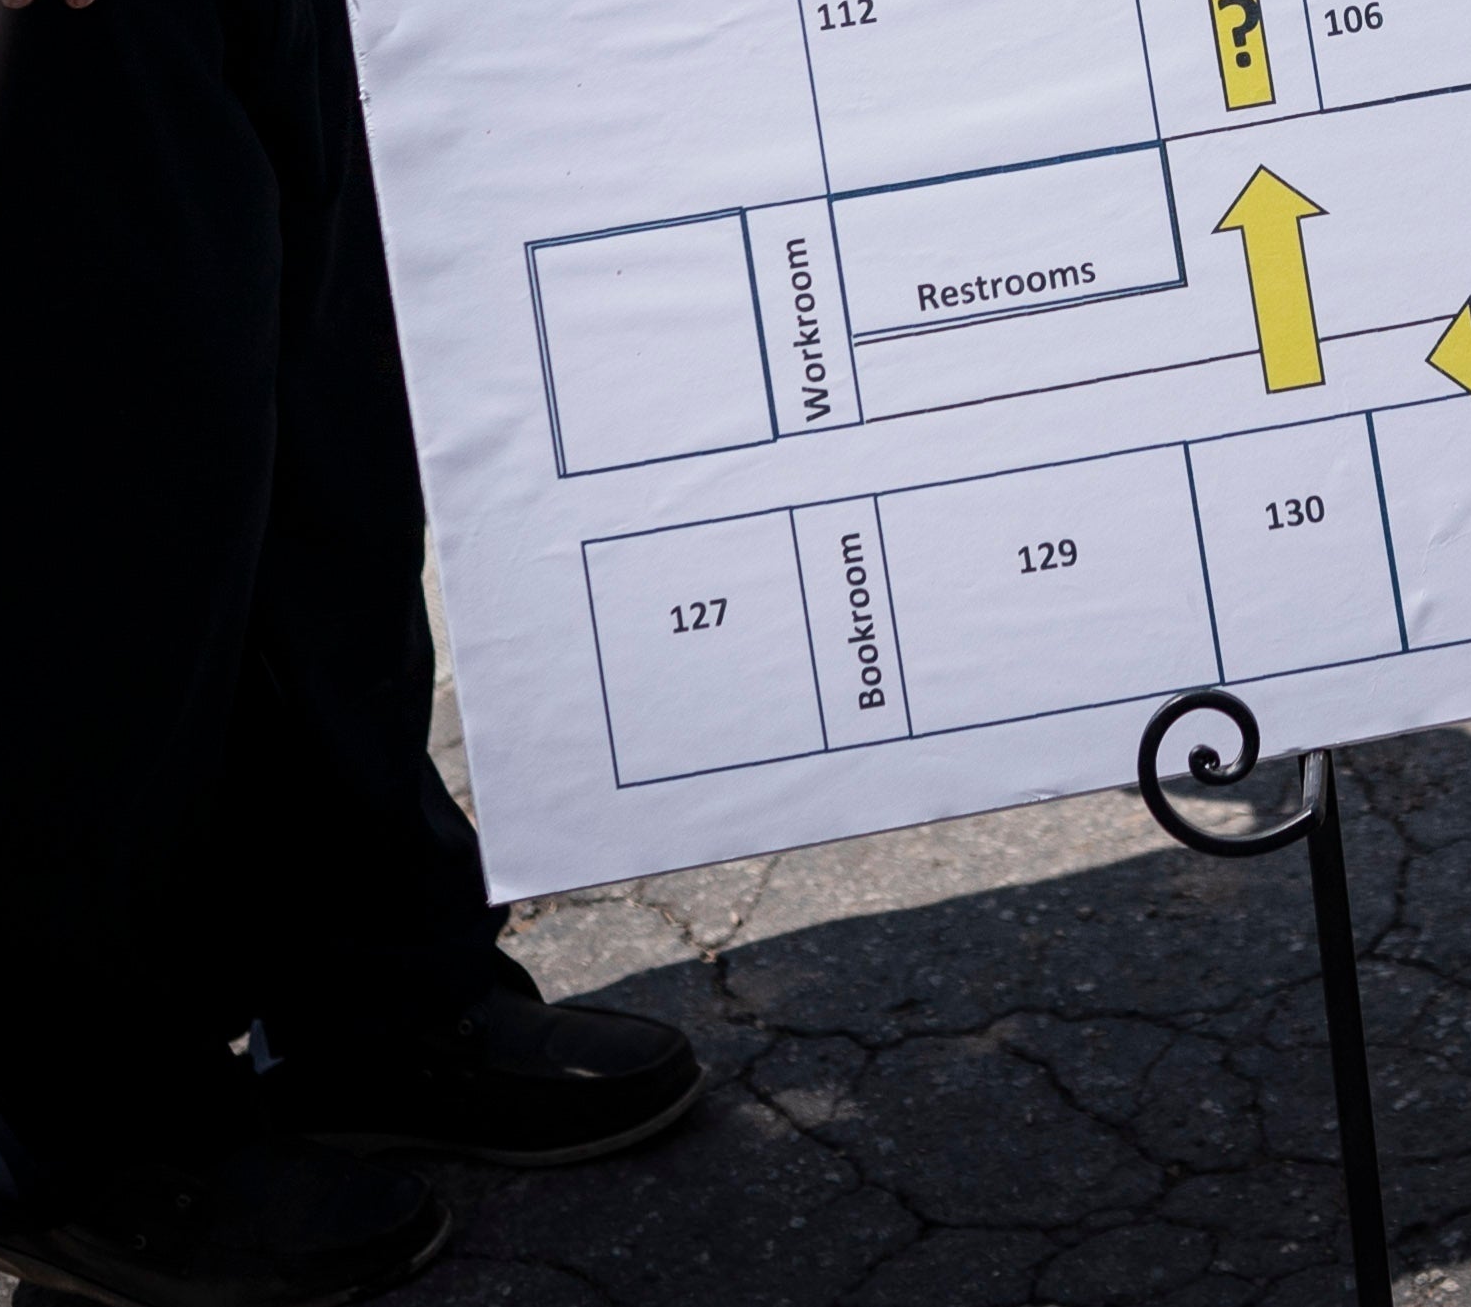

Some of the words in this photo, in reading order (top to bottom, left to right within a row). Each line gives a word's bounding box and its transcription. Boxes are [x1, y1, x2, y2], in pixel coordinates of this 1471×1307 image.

[1325, 2, 1383, 36] 106
[918, 263, 1095, 311] Restrooms
[787, 239, 830, 421] Workroom
[1266, 496, 1324, 530] 130
[1019, 540, 1077, 573] 129
[671, 598, 727, 633] 127
[841, 533, 885, 709] Bookroom
